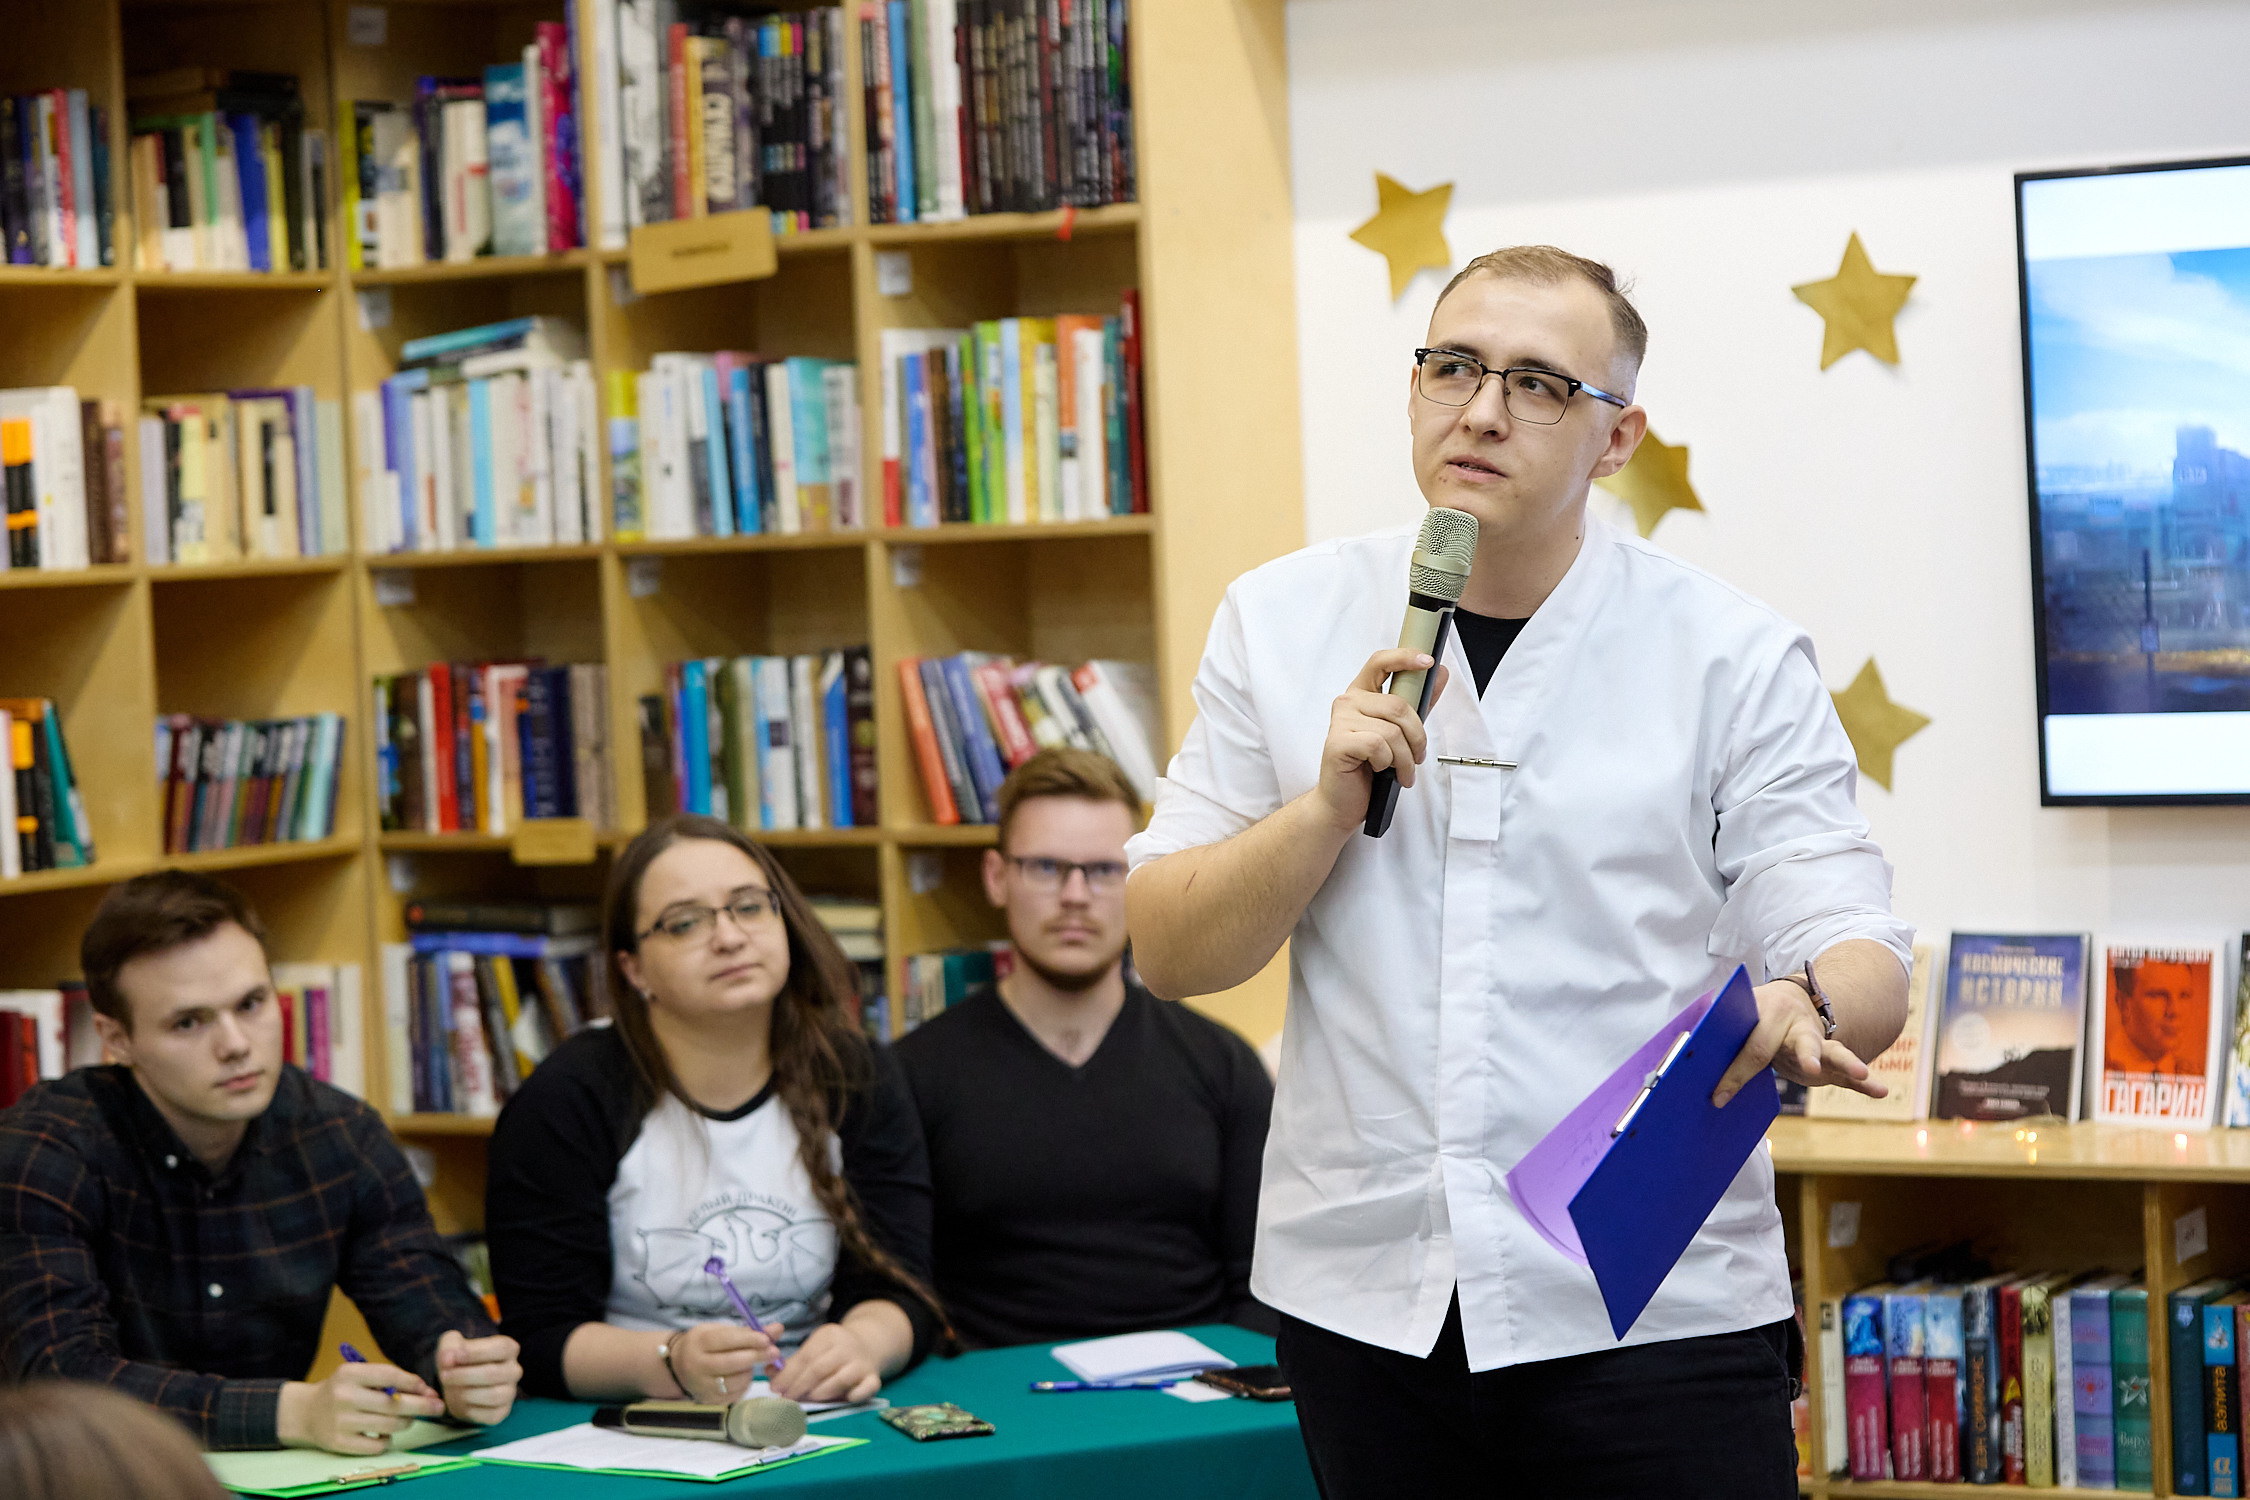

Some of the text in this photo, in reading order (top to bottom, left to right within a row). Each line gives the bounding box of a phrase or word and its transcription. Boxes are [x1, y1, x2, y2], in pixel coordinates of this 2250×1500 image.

[1959, 974, 2063, 1009] ИСТОРИИ
[2104, 1080, 2206, 1118] ГАГАРИН
[2214, 1366, 2228, 1432] аэлита
